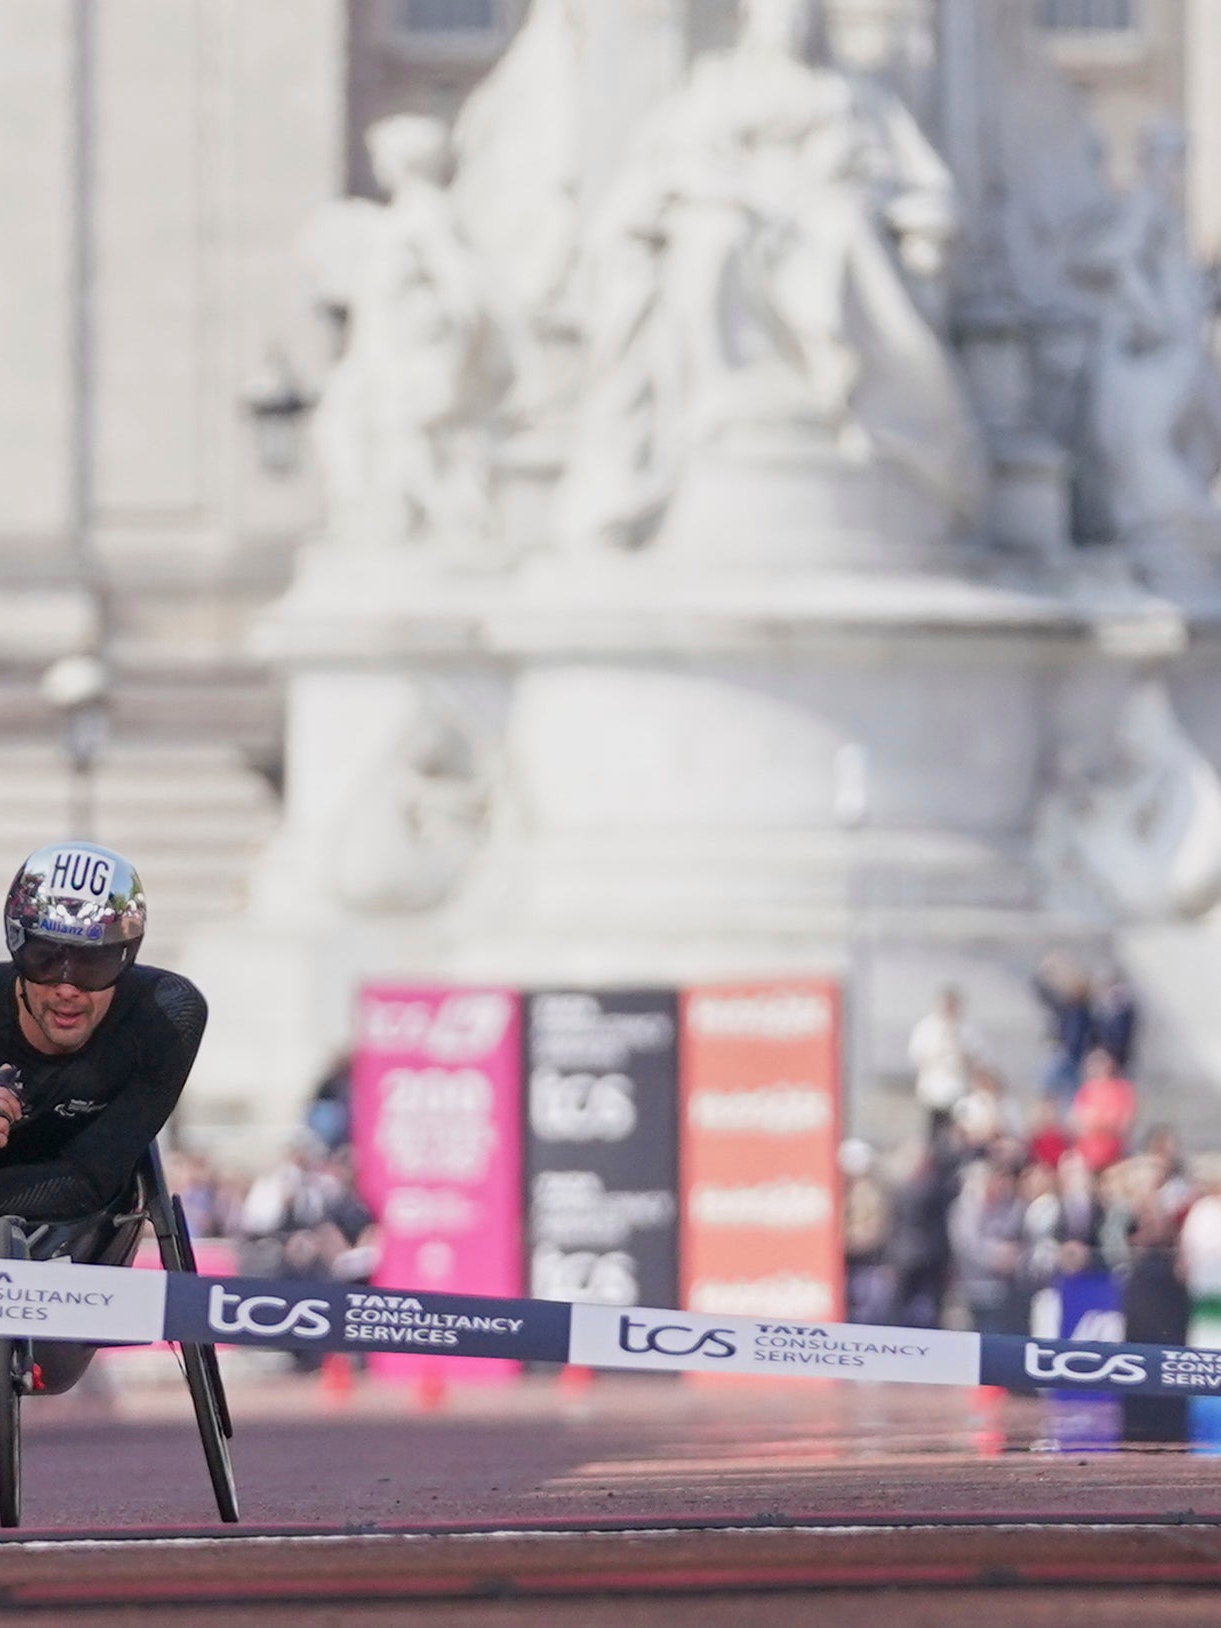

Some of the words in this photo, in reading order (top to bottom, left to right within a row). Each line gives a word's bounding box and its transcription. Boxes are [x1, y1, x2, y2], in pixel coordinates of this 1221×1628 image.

[50, 853, 110, 897] HUG
[39, 918, 84, 936] Allianz
[208, 1284, 331, 1338] tcs
[345, 1293, 423, 1311] TATA
[344, 1308, 524, 1333] CONSULTANCY
[754, 1323, 830, 1338] TATA
[343, 1324, 459, 1345] SERVICES
[619, 1313, 737, 1359] tcs
[754, 1335, 930, 1357] CONSULTANCY
[754, 1348, 866, 1367] SERVICES
[1024, 1341, 1149, 1386] tcs
